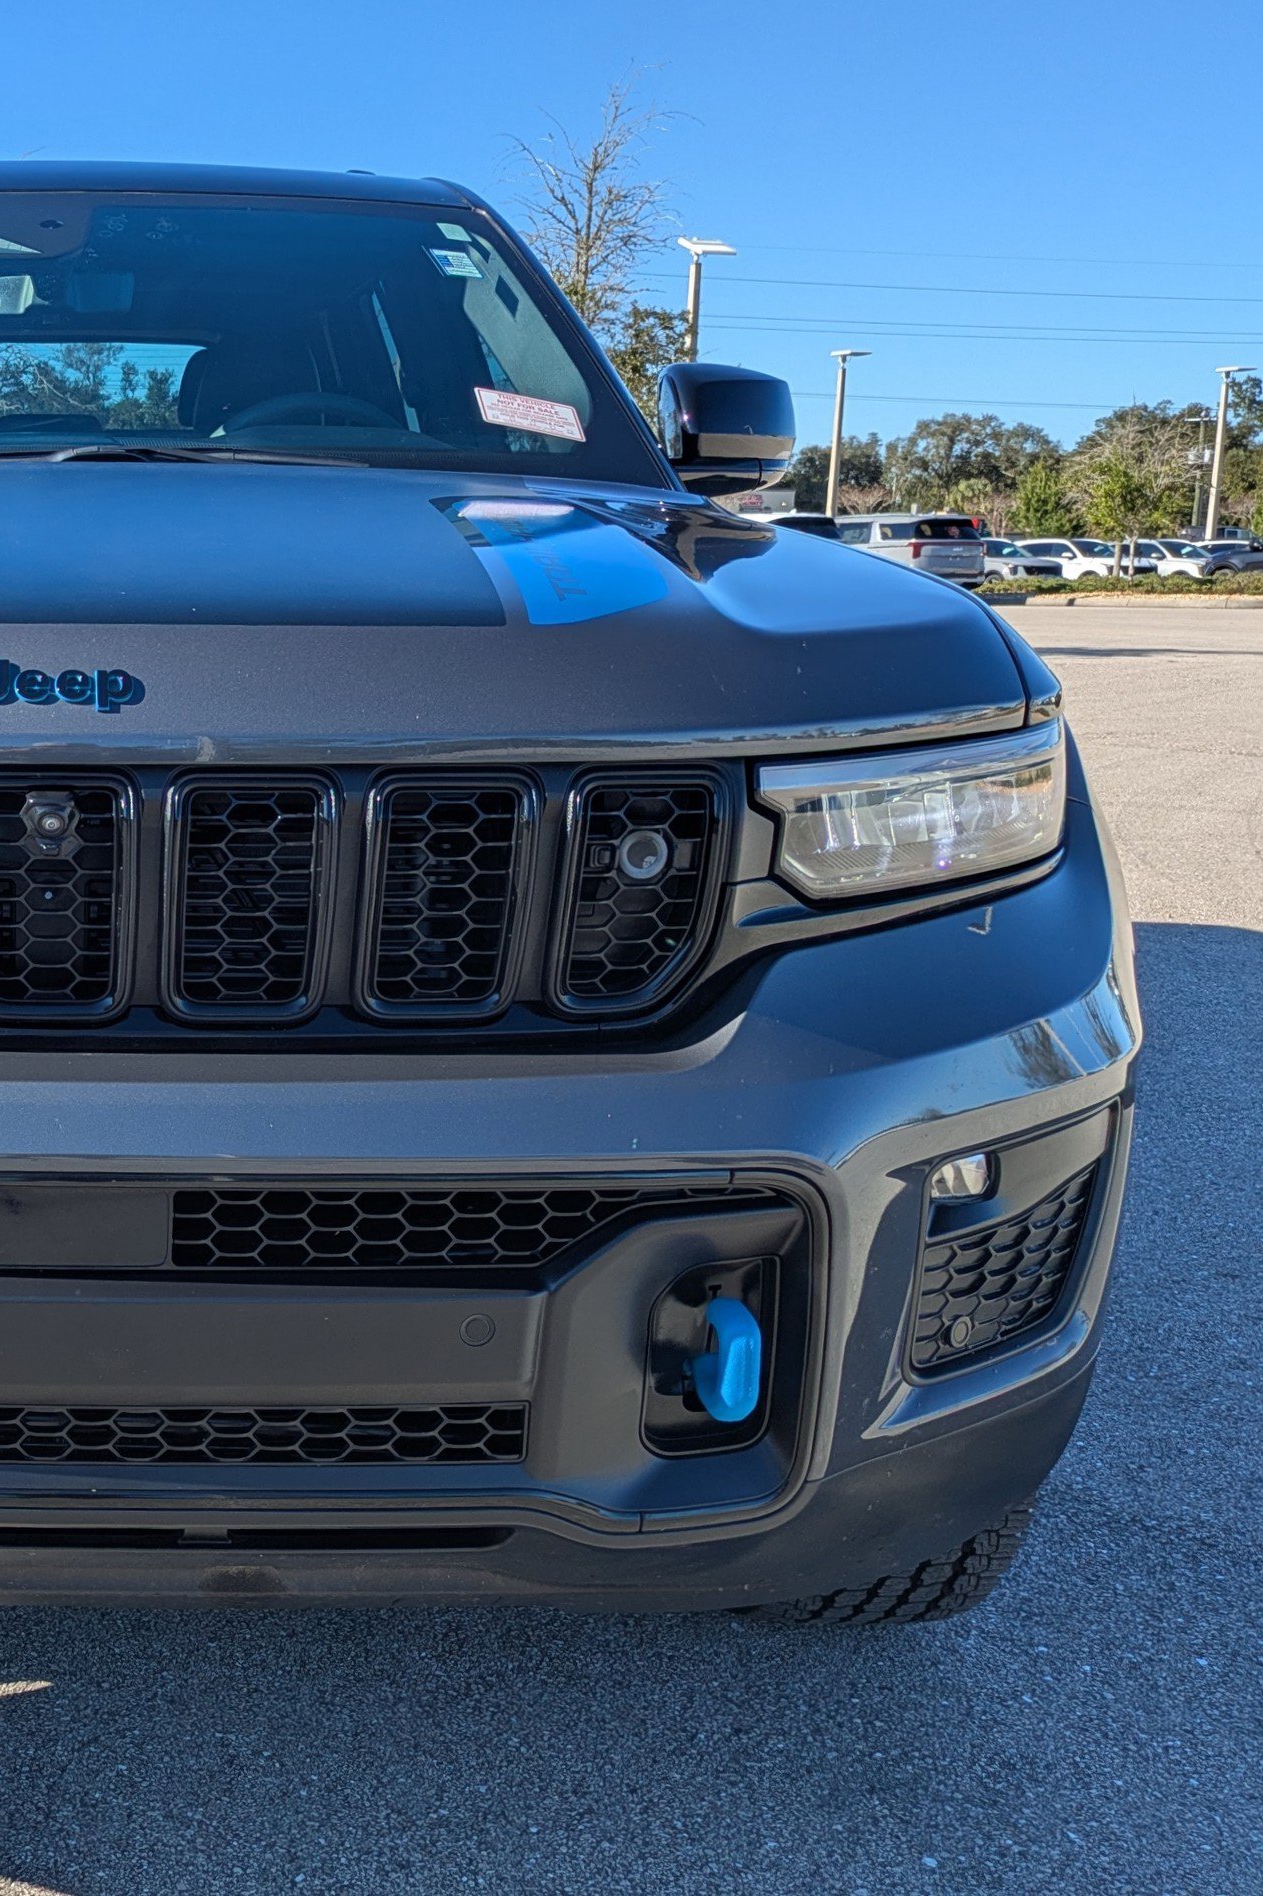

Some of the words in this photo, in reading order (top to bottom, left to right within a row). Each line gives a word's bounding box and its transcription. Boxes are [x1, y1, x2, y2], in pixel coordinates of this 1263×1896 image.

[497, 399, 514, 407] NOT
[517, 402, 536, 411] FOR
[537, 407, 561, 416] SALE
